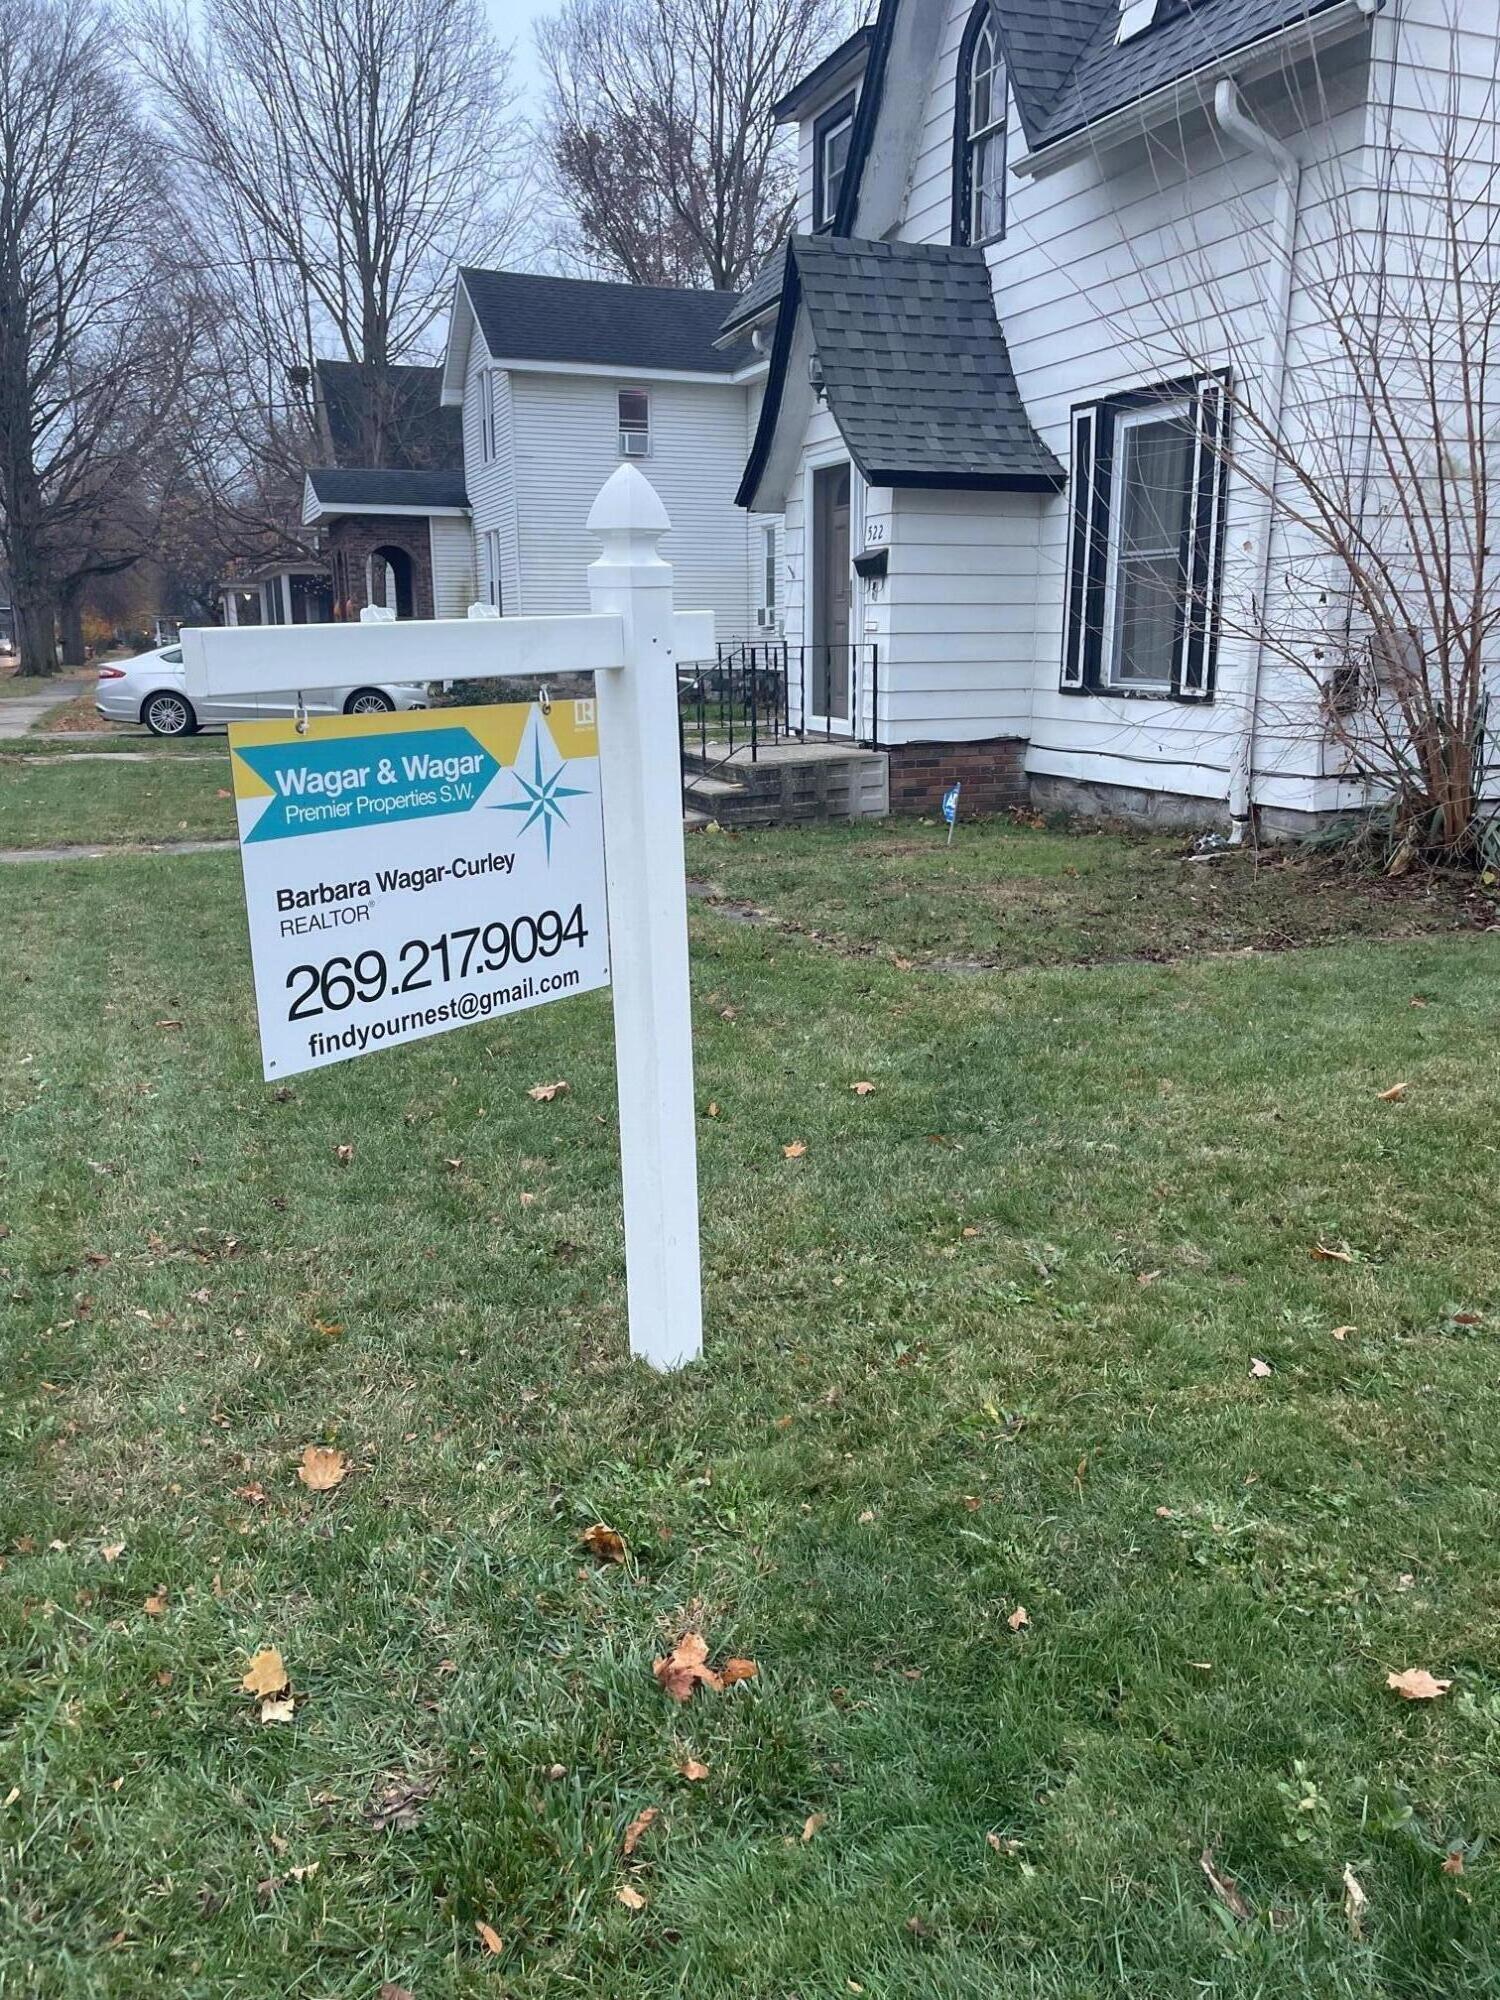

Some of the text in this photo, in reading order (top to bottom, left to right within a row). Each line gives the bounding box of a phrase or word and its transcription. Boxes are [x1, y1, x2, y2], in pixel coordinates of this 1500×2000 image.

[867, 524, 884, 541] 522
[275, 754, 484, 798] Wagar & Wagar
[285, 782, 475, 825] Premier Properties S.W.
[276, 853, 516, 912] Barbara Wagar-Curley
[285, 903, 589, 1022] 269.217.9094
[308, 969, 580, 1058] findyournest@gmail.com
